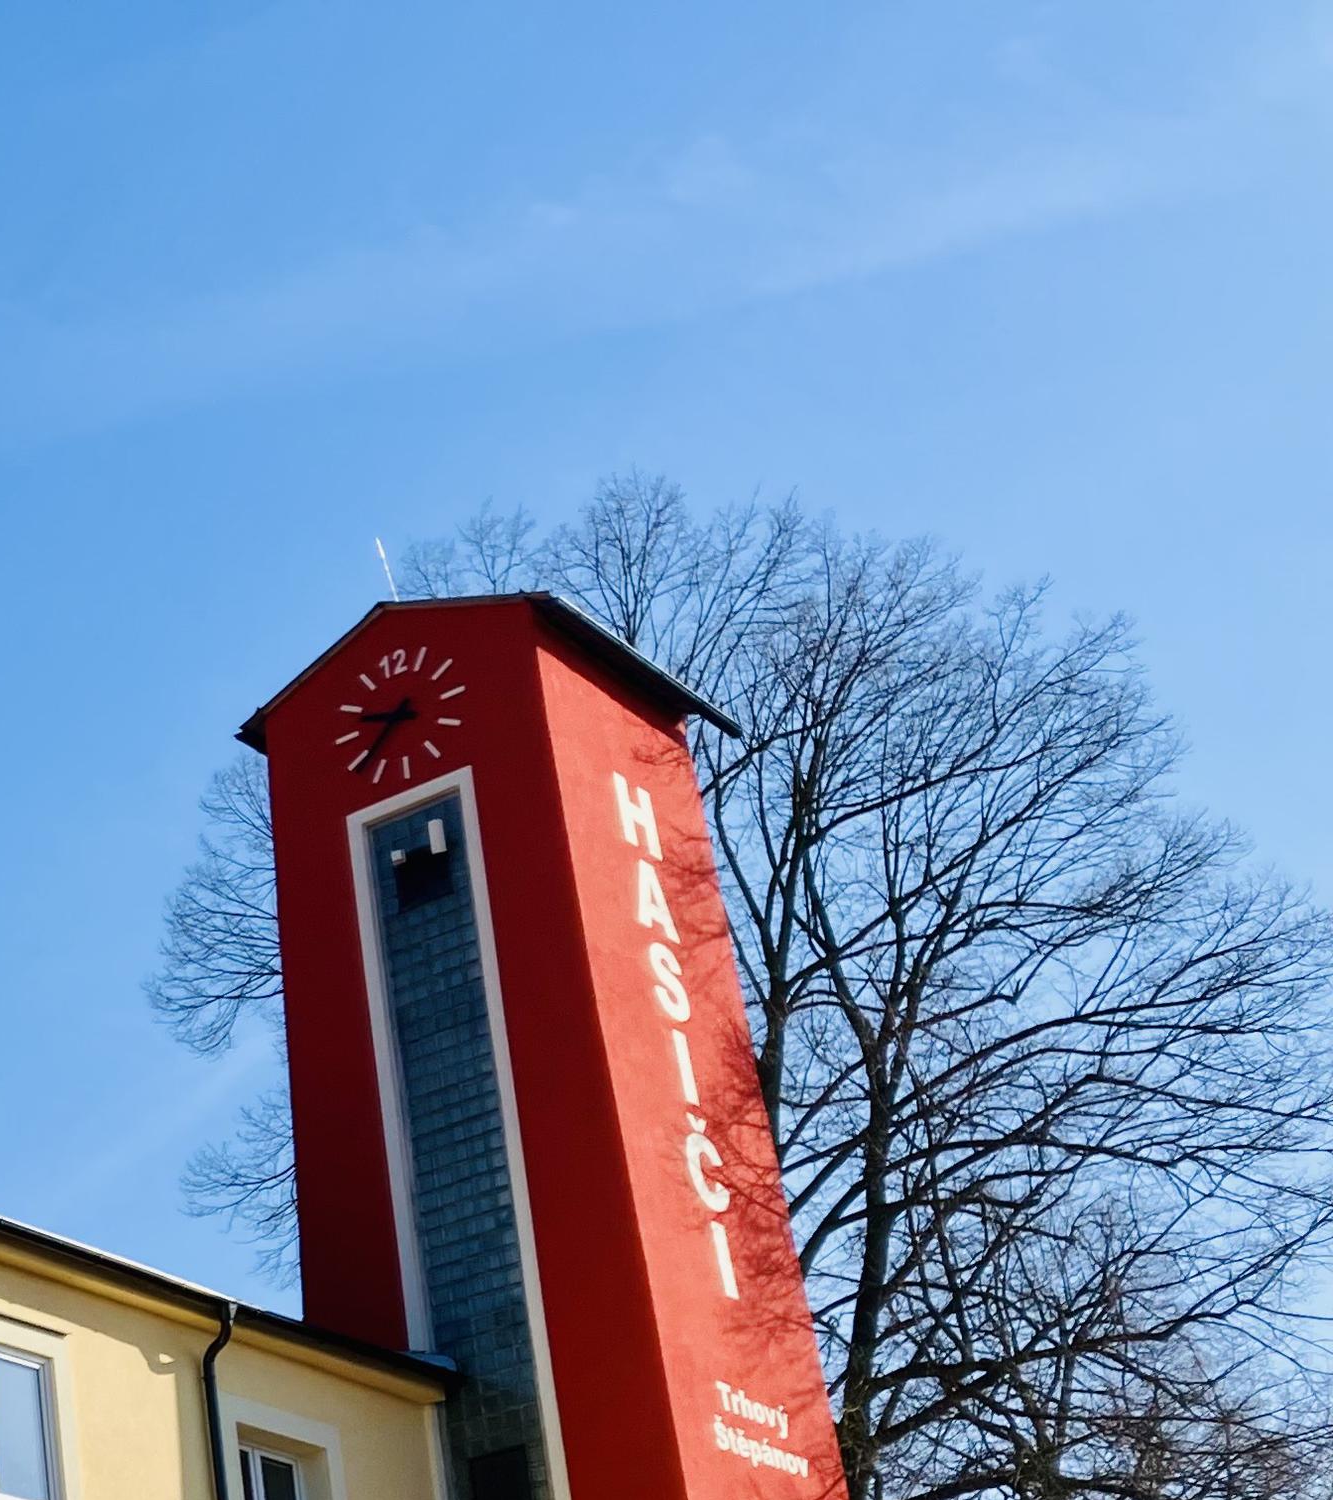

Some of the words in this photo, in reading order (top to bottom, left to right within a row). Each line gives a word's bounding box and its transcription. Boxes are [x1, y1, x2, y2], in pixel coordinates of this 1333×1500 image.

[379, 648, 409, 679] 12
[612, 769, 741, 1301] HASIČI
[714, 1379, 789, 1440] Trhový
[713, 1413, 810, 1478] Štěpánov
